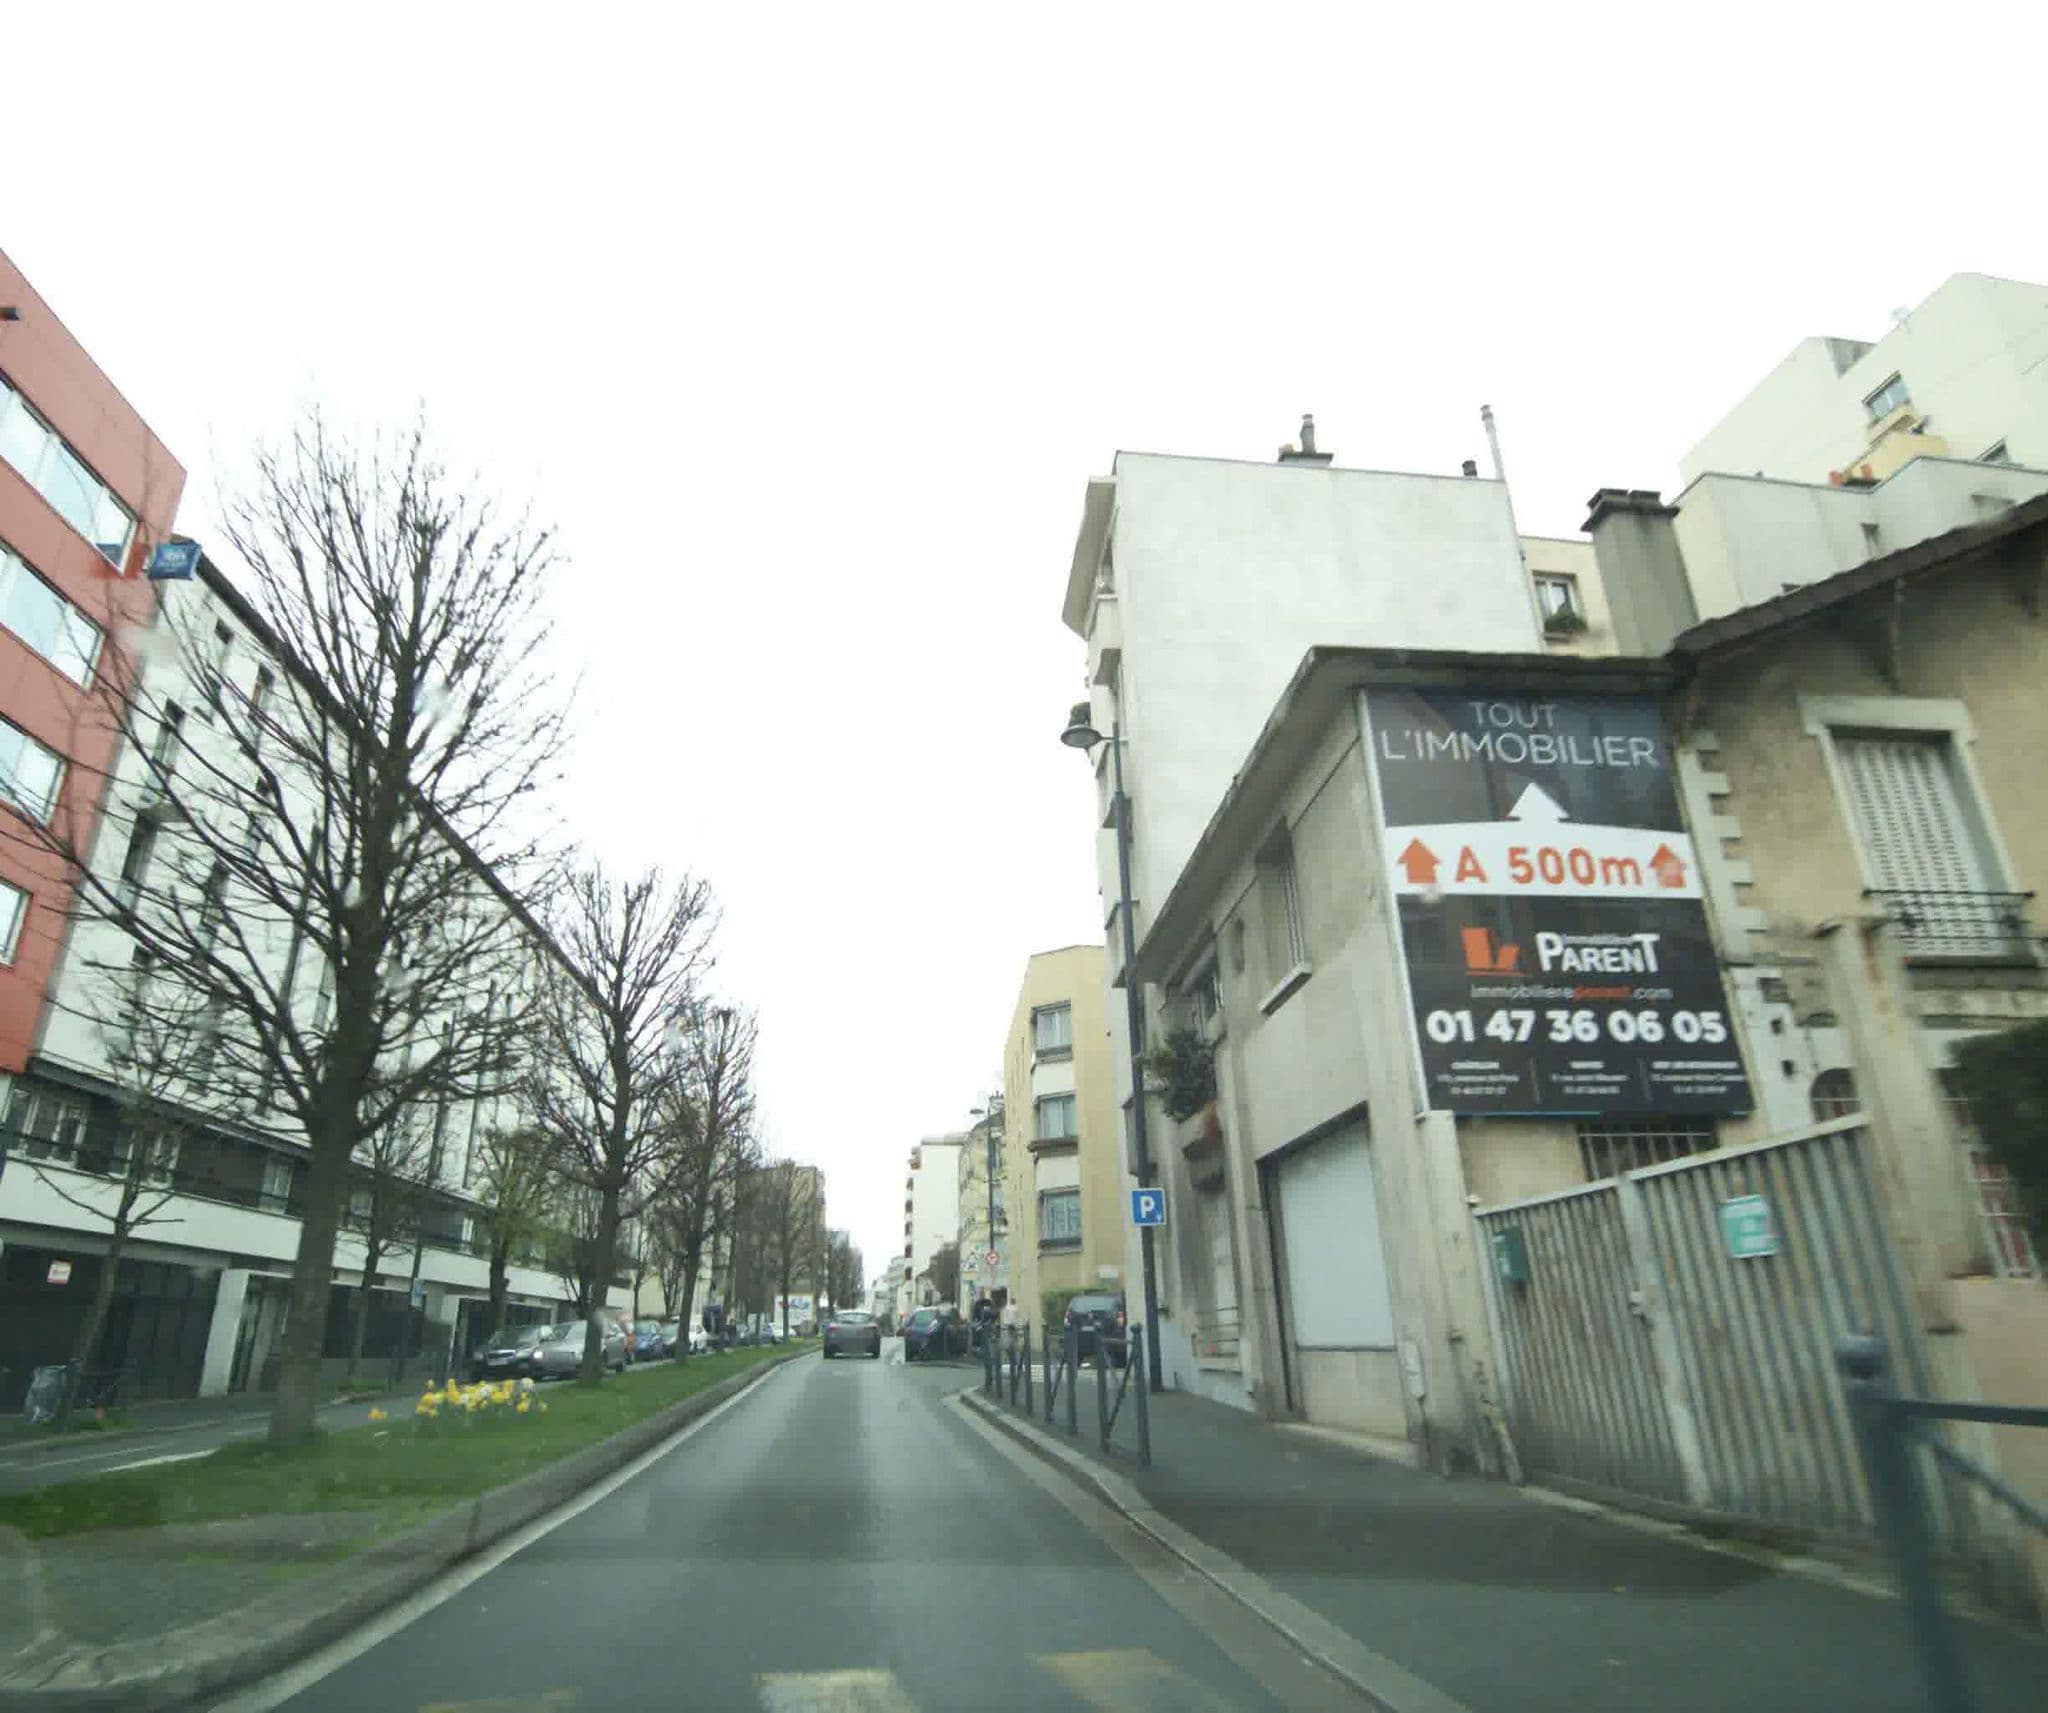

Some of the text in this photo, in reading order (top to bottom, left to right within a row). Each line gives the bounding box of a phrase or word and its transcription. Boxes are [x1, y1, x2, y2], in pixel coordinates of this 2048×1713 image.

[1468, 702, 1559, 729] TOUT
[1380, 730, 1660, 768] L'IMMOBILIER
[1455, 845, 1642, 886] A 500m
[1535, 932, 1661, 973] PARENT
[1426, 1009, 1728, 1044] 01 47 36 06 05
[1140, 1195, 1156, 1219] P
